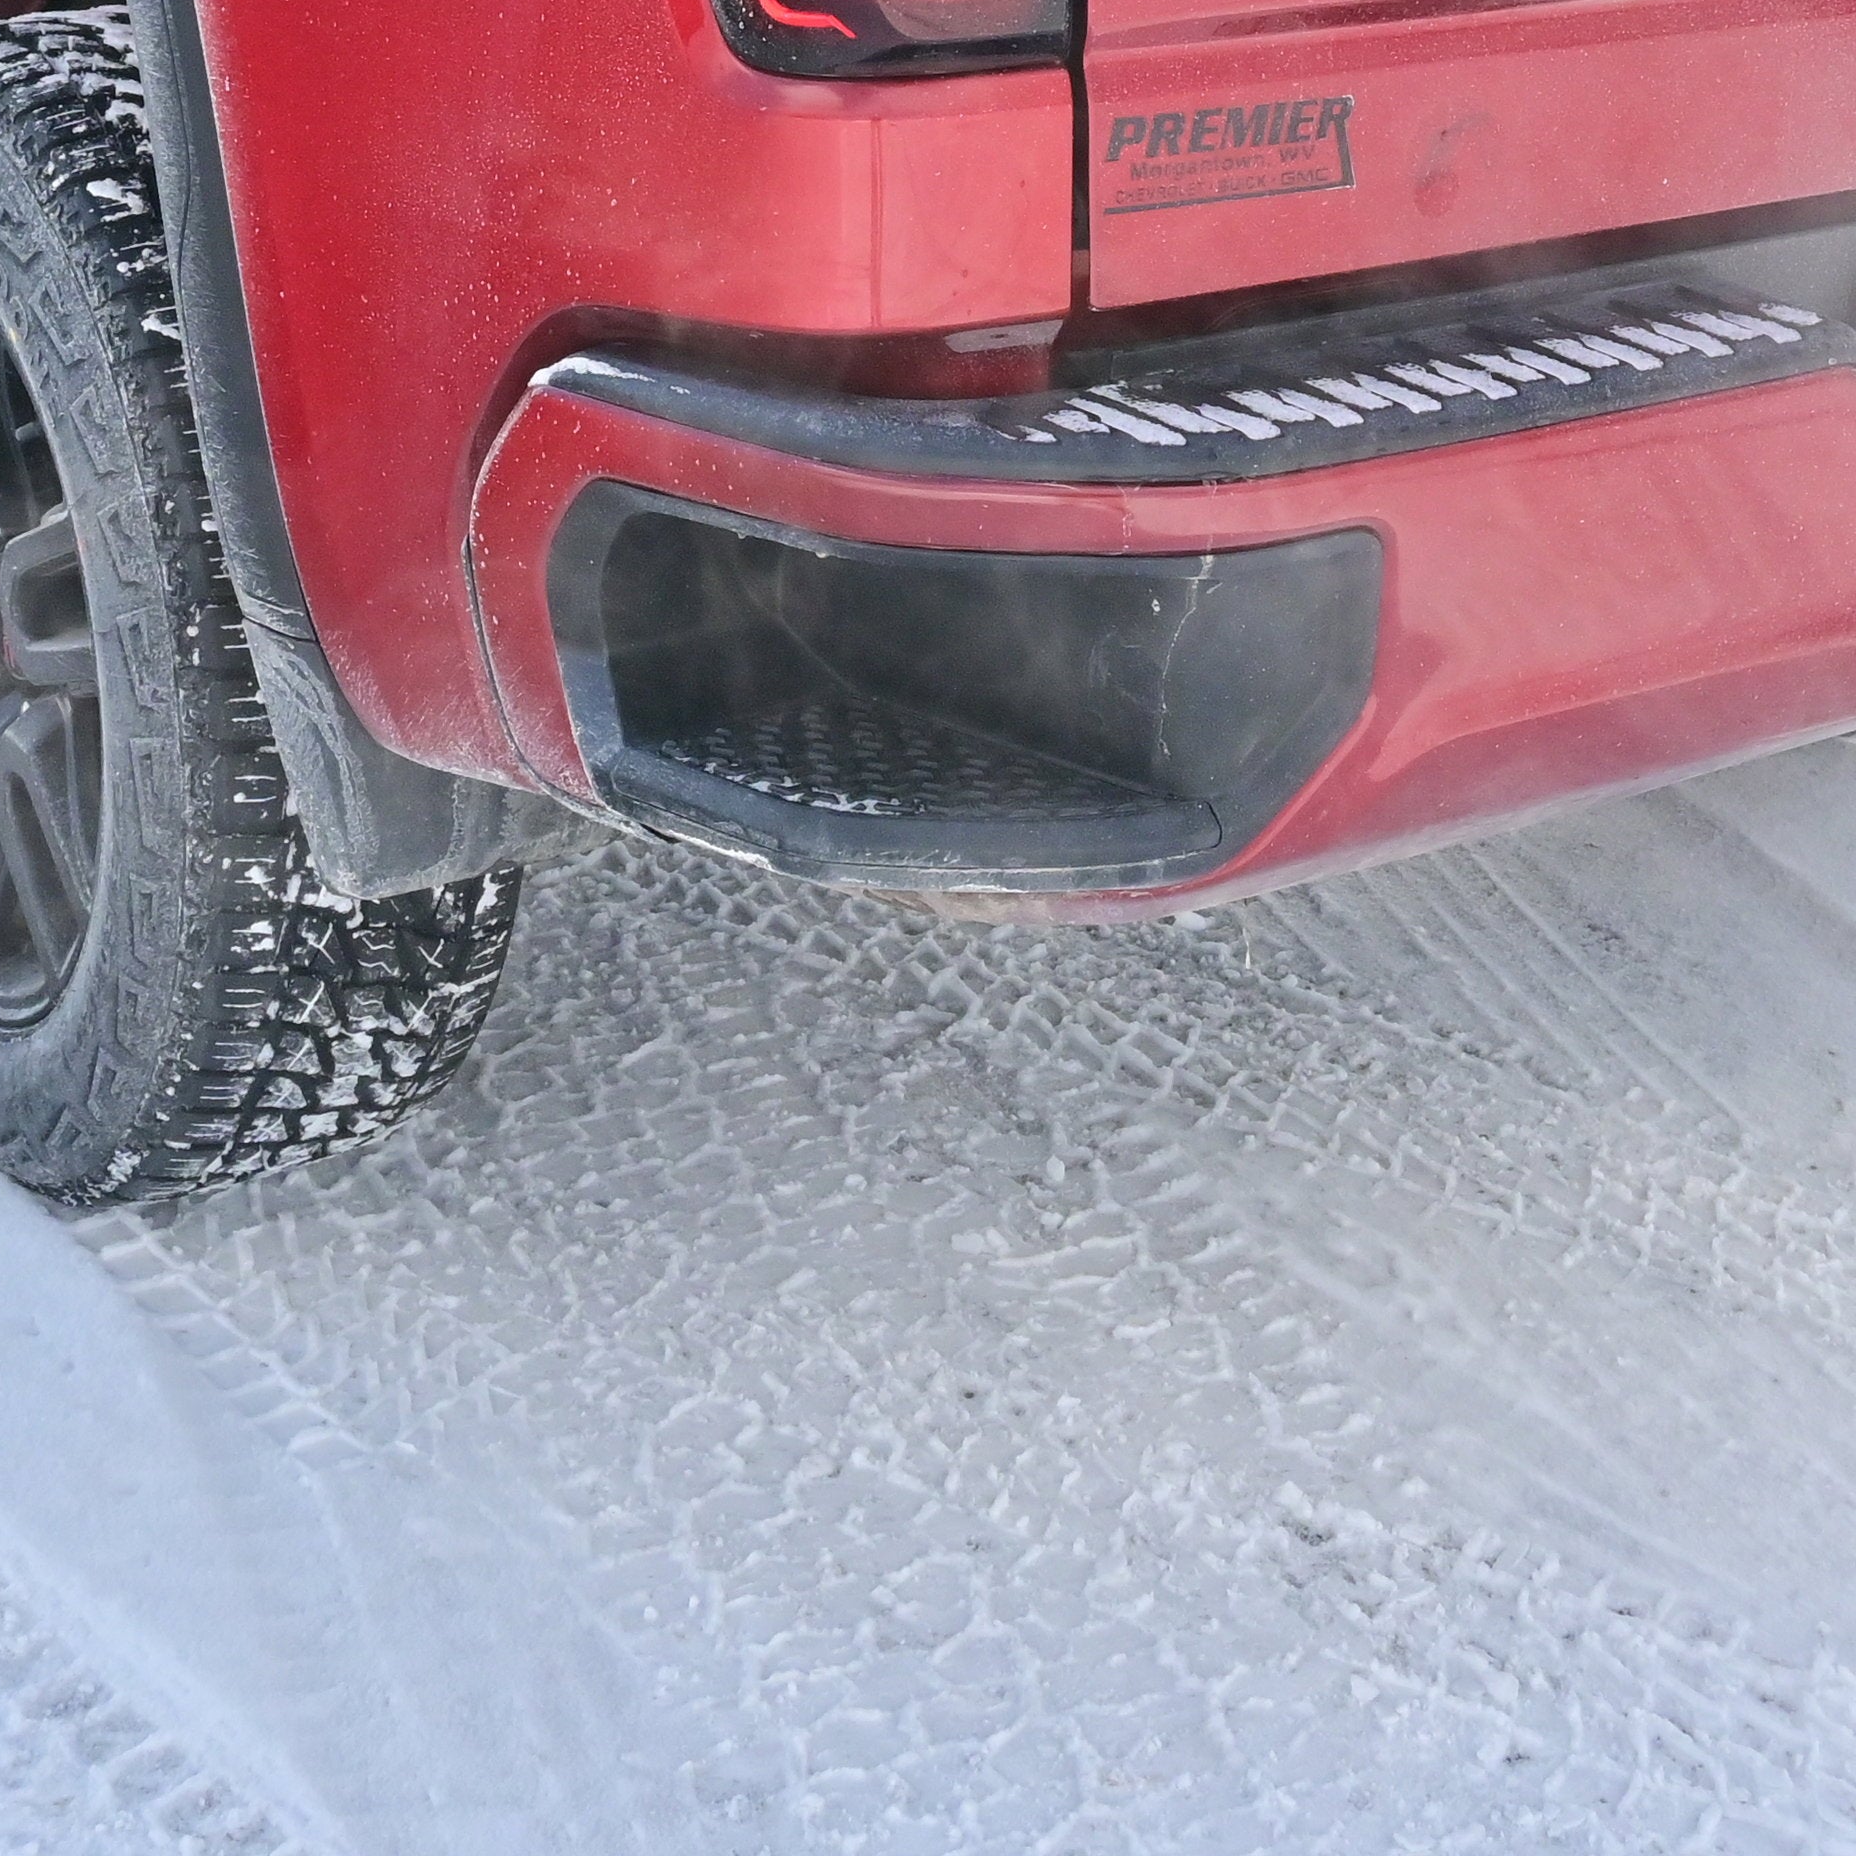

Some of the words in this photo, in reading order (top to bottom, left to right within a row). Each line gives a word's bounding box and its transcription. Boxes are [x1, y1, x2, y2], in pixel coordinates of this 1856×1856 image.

[1104, 94, 1355, 163] PREMIER
[1280, 145, 1315, 163] WV
[1280, 167, 1330, 185] GMC
